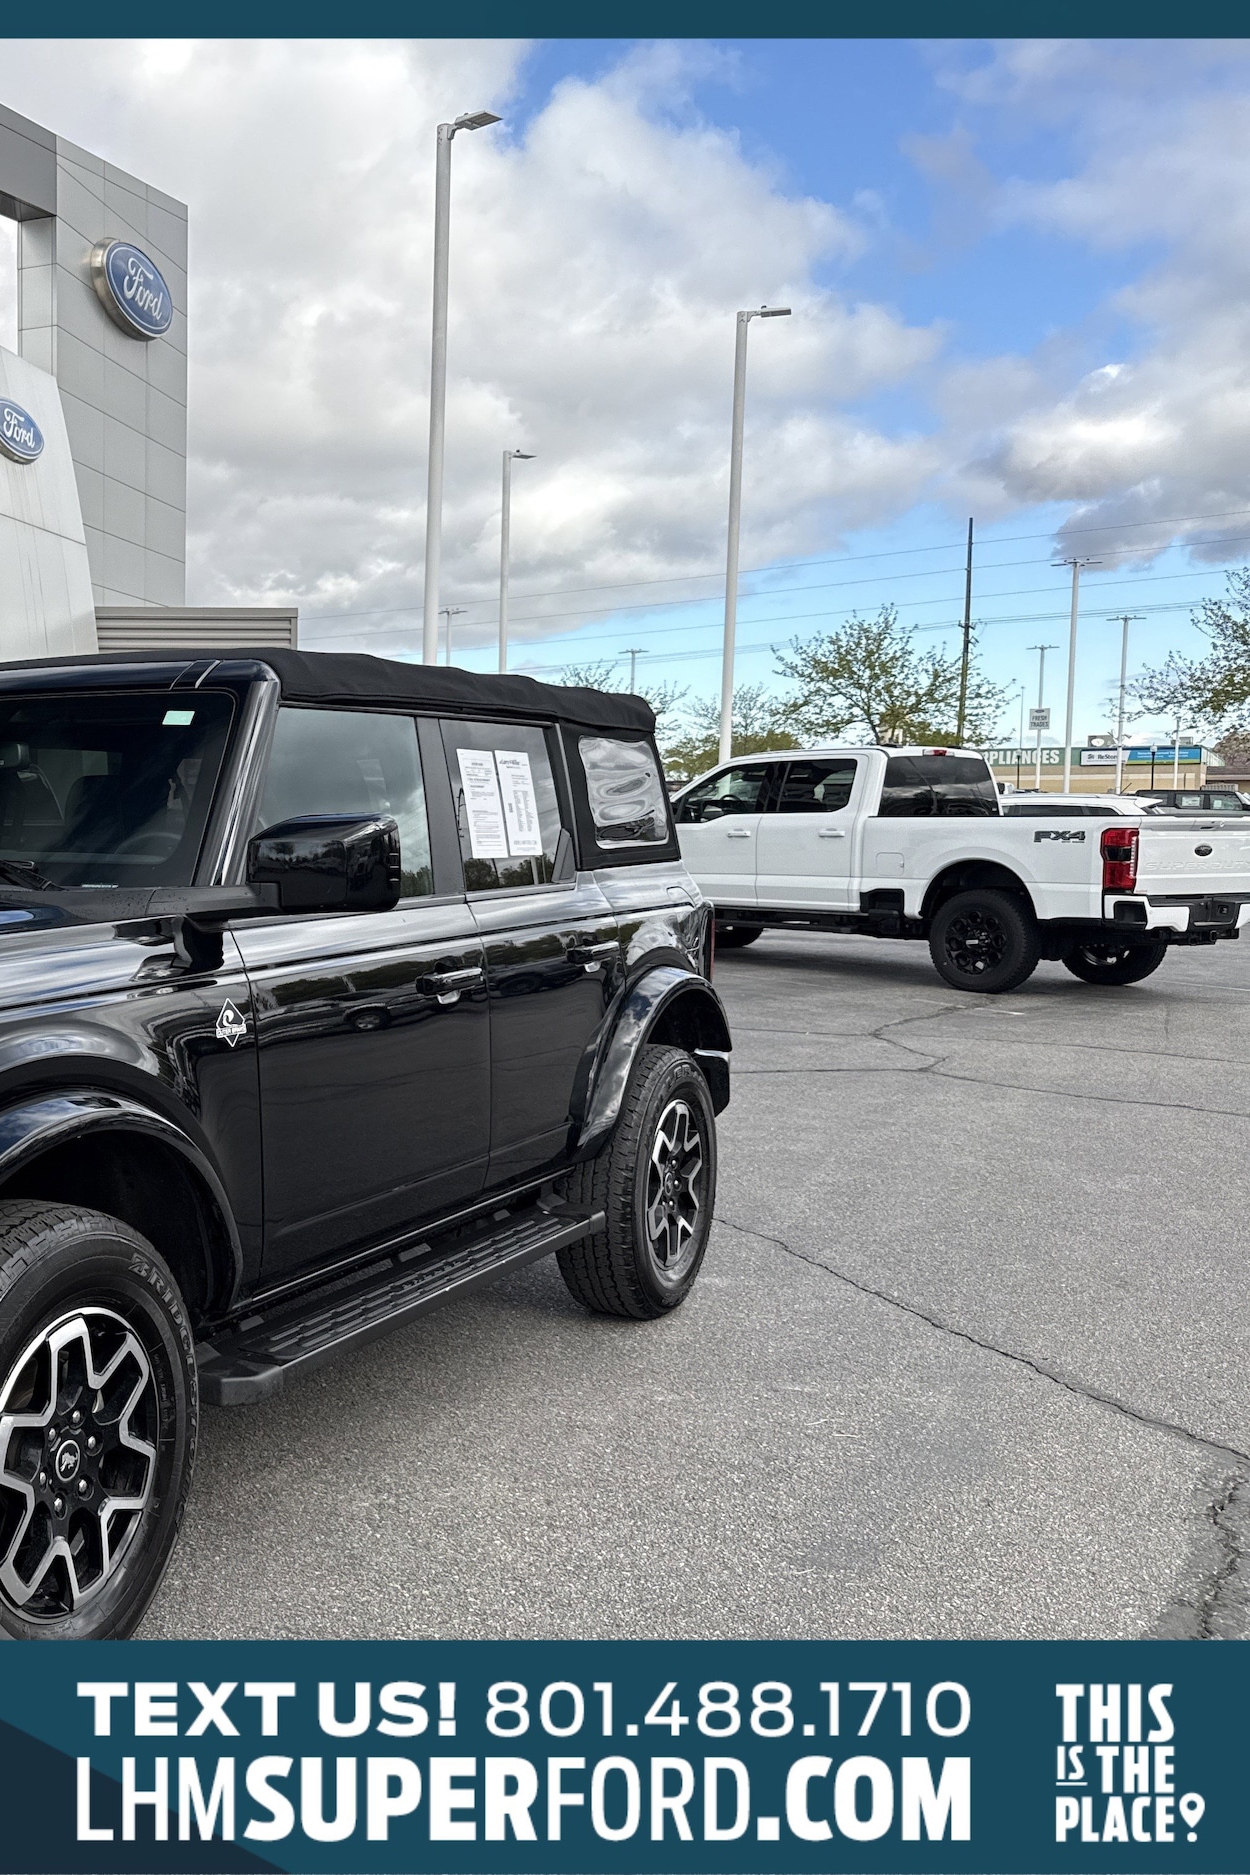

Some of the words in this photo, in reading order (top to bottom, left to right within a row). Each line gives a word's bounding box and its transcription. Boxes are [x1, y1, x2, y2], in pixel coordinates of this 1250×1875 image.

[123, 257, 164, 320] Ford
[2, 407, 36, 449] Ford
[1033, 830, 1086, 843] FX4
